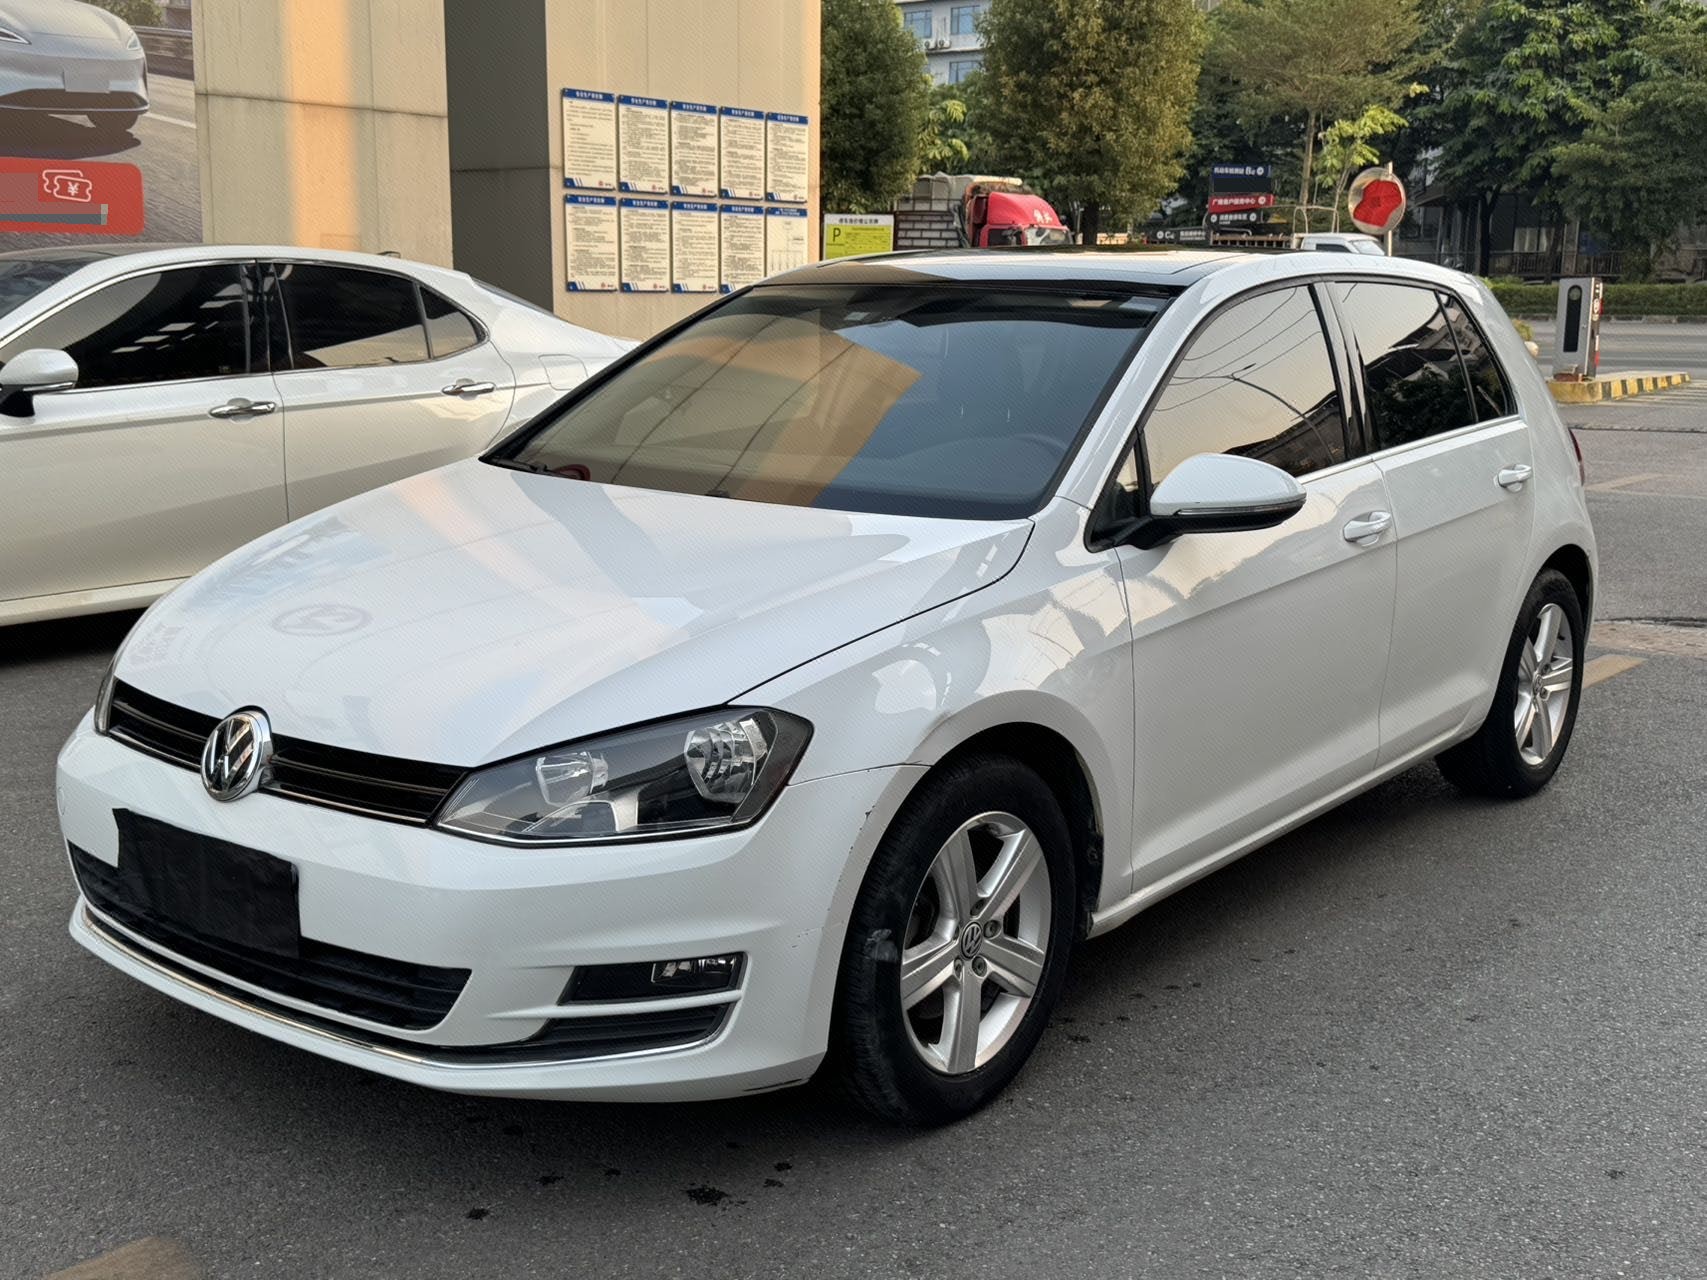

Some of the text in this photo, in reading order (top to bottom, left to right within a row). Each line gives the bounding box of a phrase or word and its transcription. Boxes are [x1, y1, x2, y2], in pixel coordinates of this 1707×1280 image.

[832, 227, 841, 242] P
[203, 716, 256, 796] VW
[962, 922, 982, 958] VW
